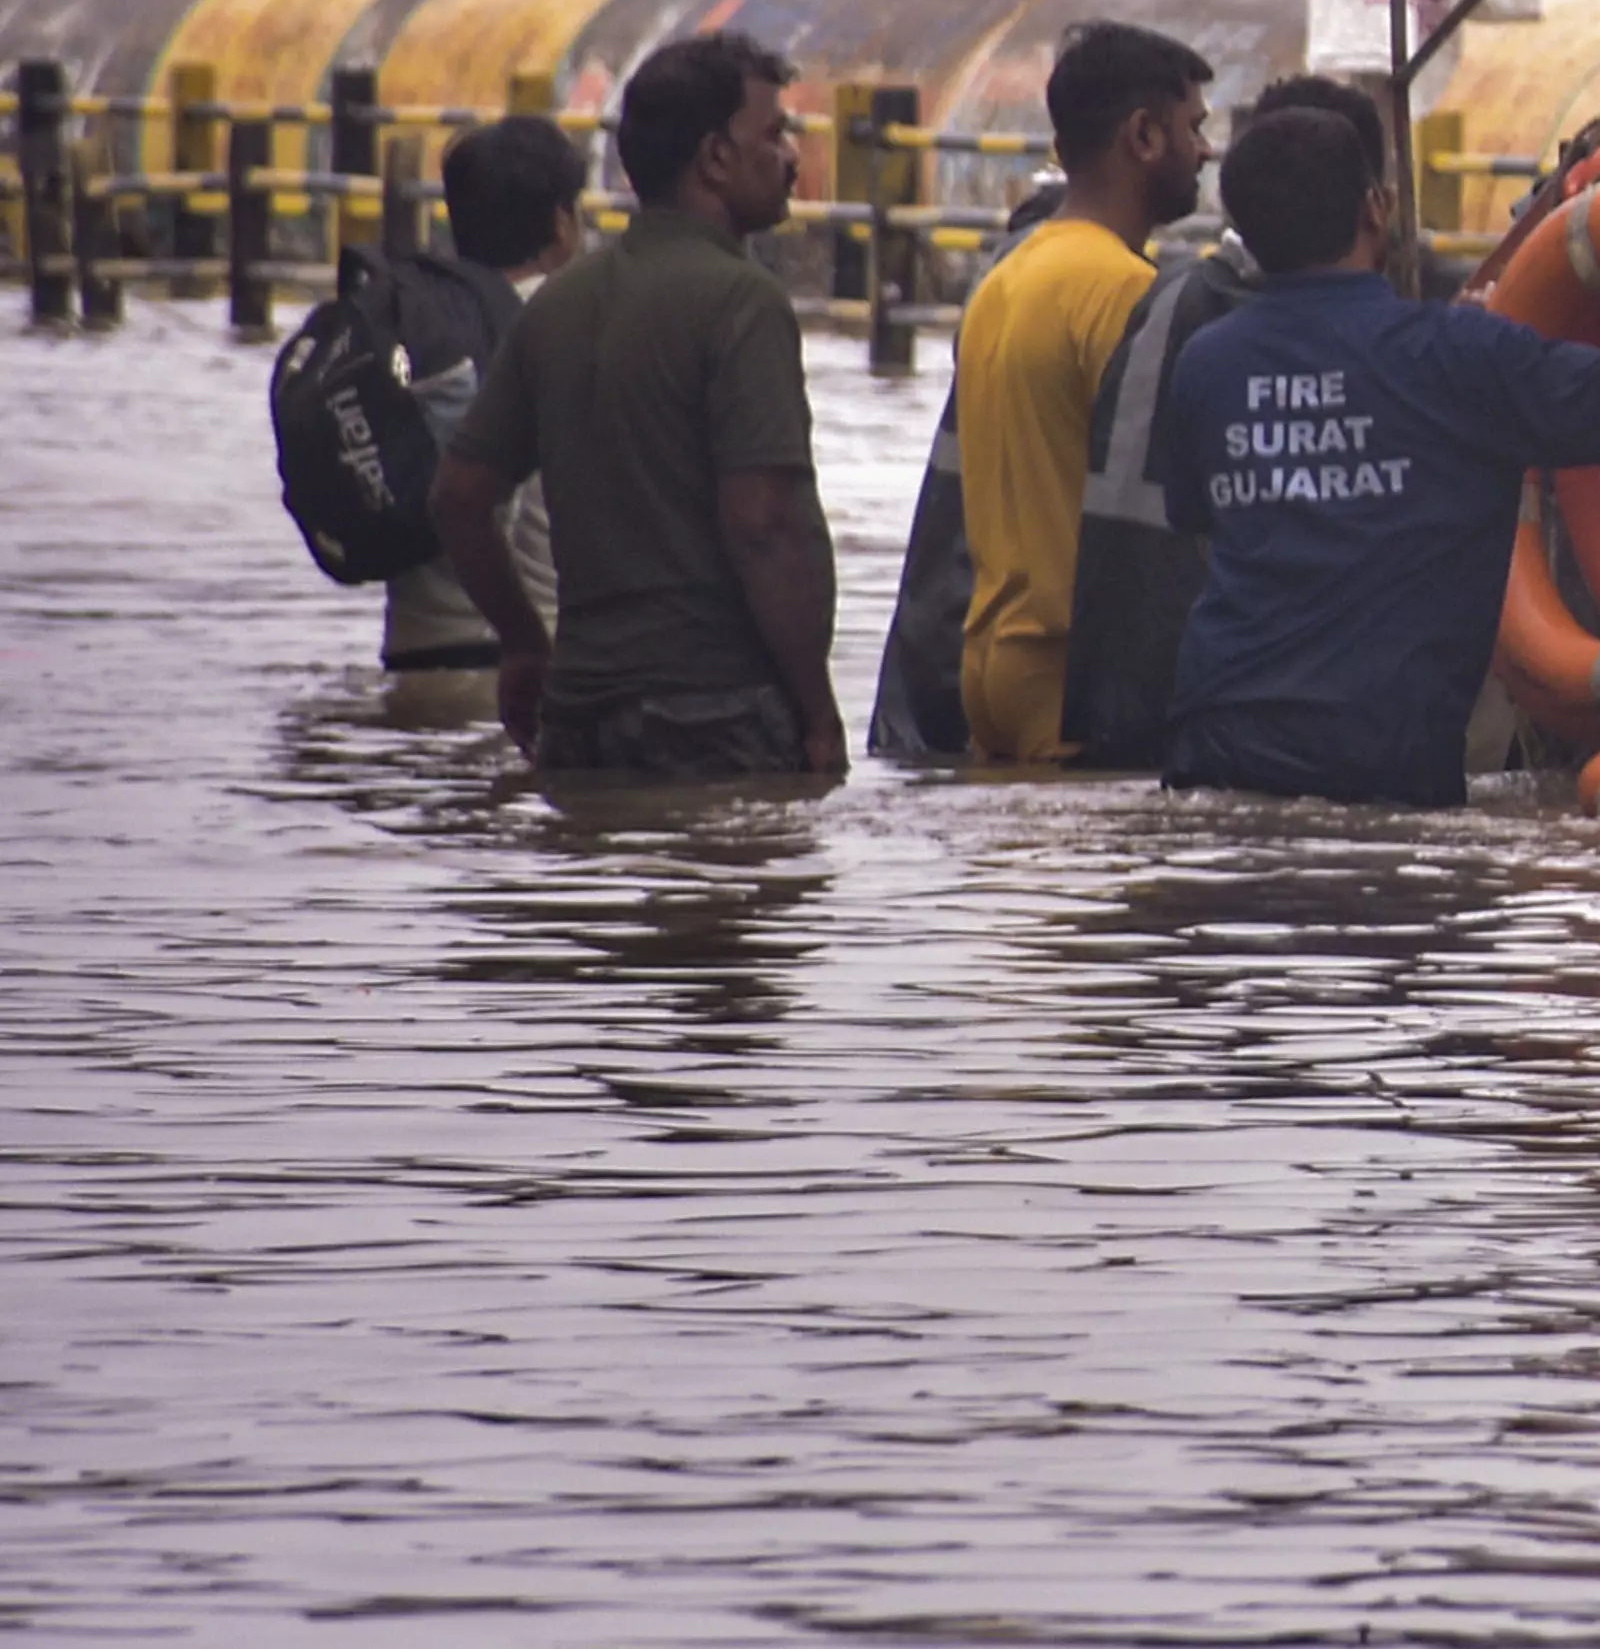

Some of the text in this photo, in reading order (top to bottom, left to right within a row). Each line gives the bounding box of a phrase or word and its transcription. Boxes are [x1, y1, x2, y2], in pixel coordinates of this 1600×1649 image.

[1248, 370, 1346, 411] FIRE
[1225, 416, 1374, 459] SURAT
[1209, 458, 1412, 508] GUJARAT
